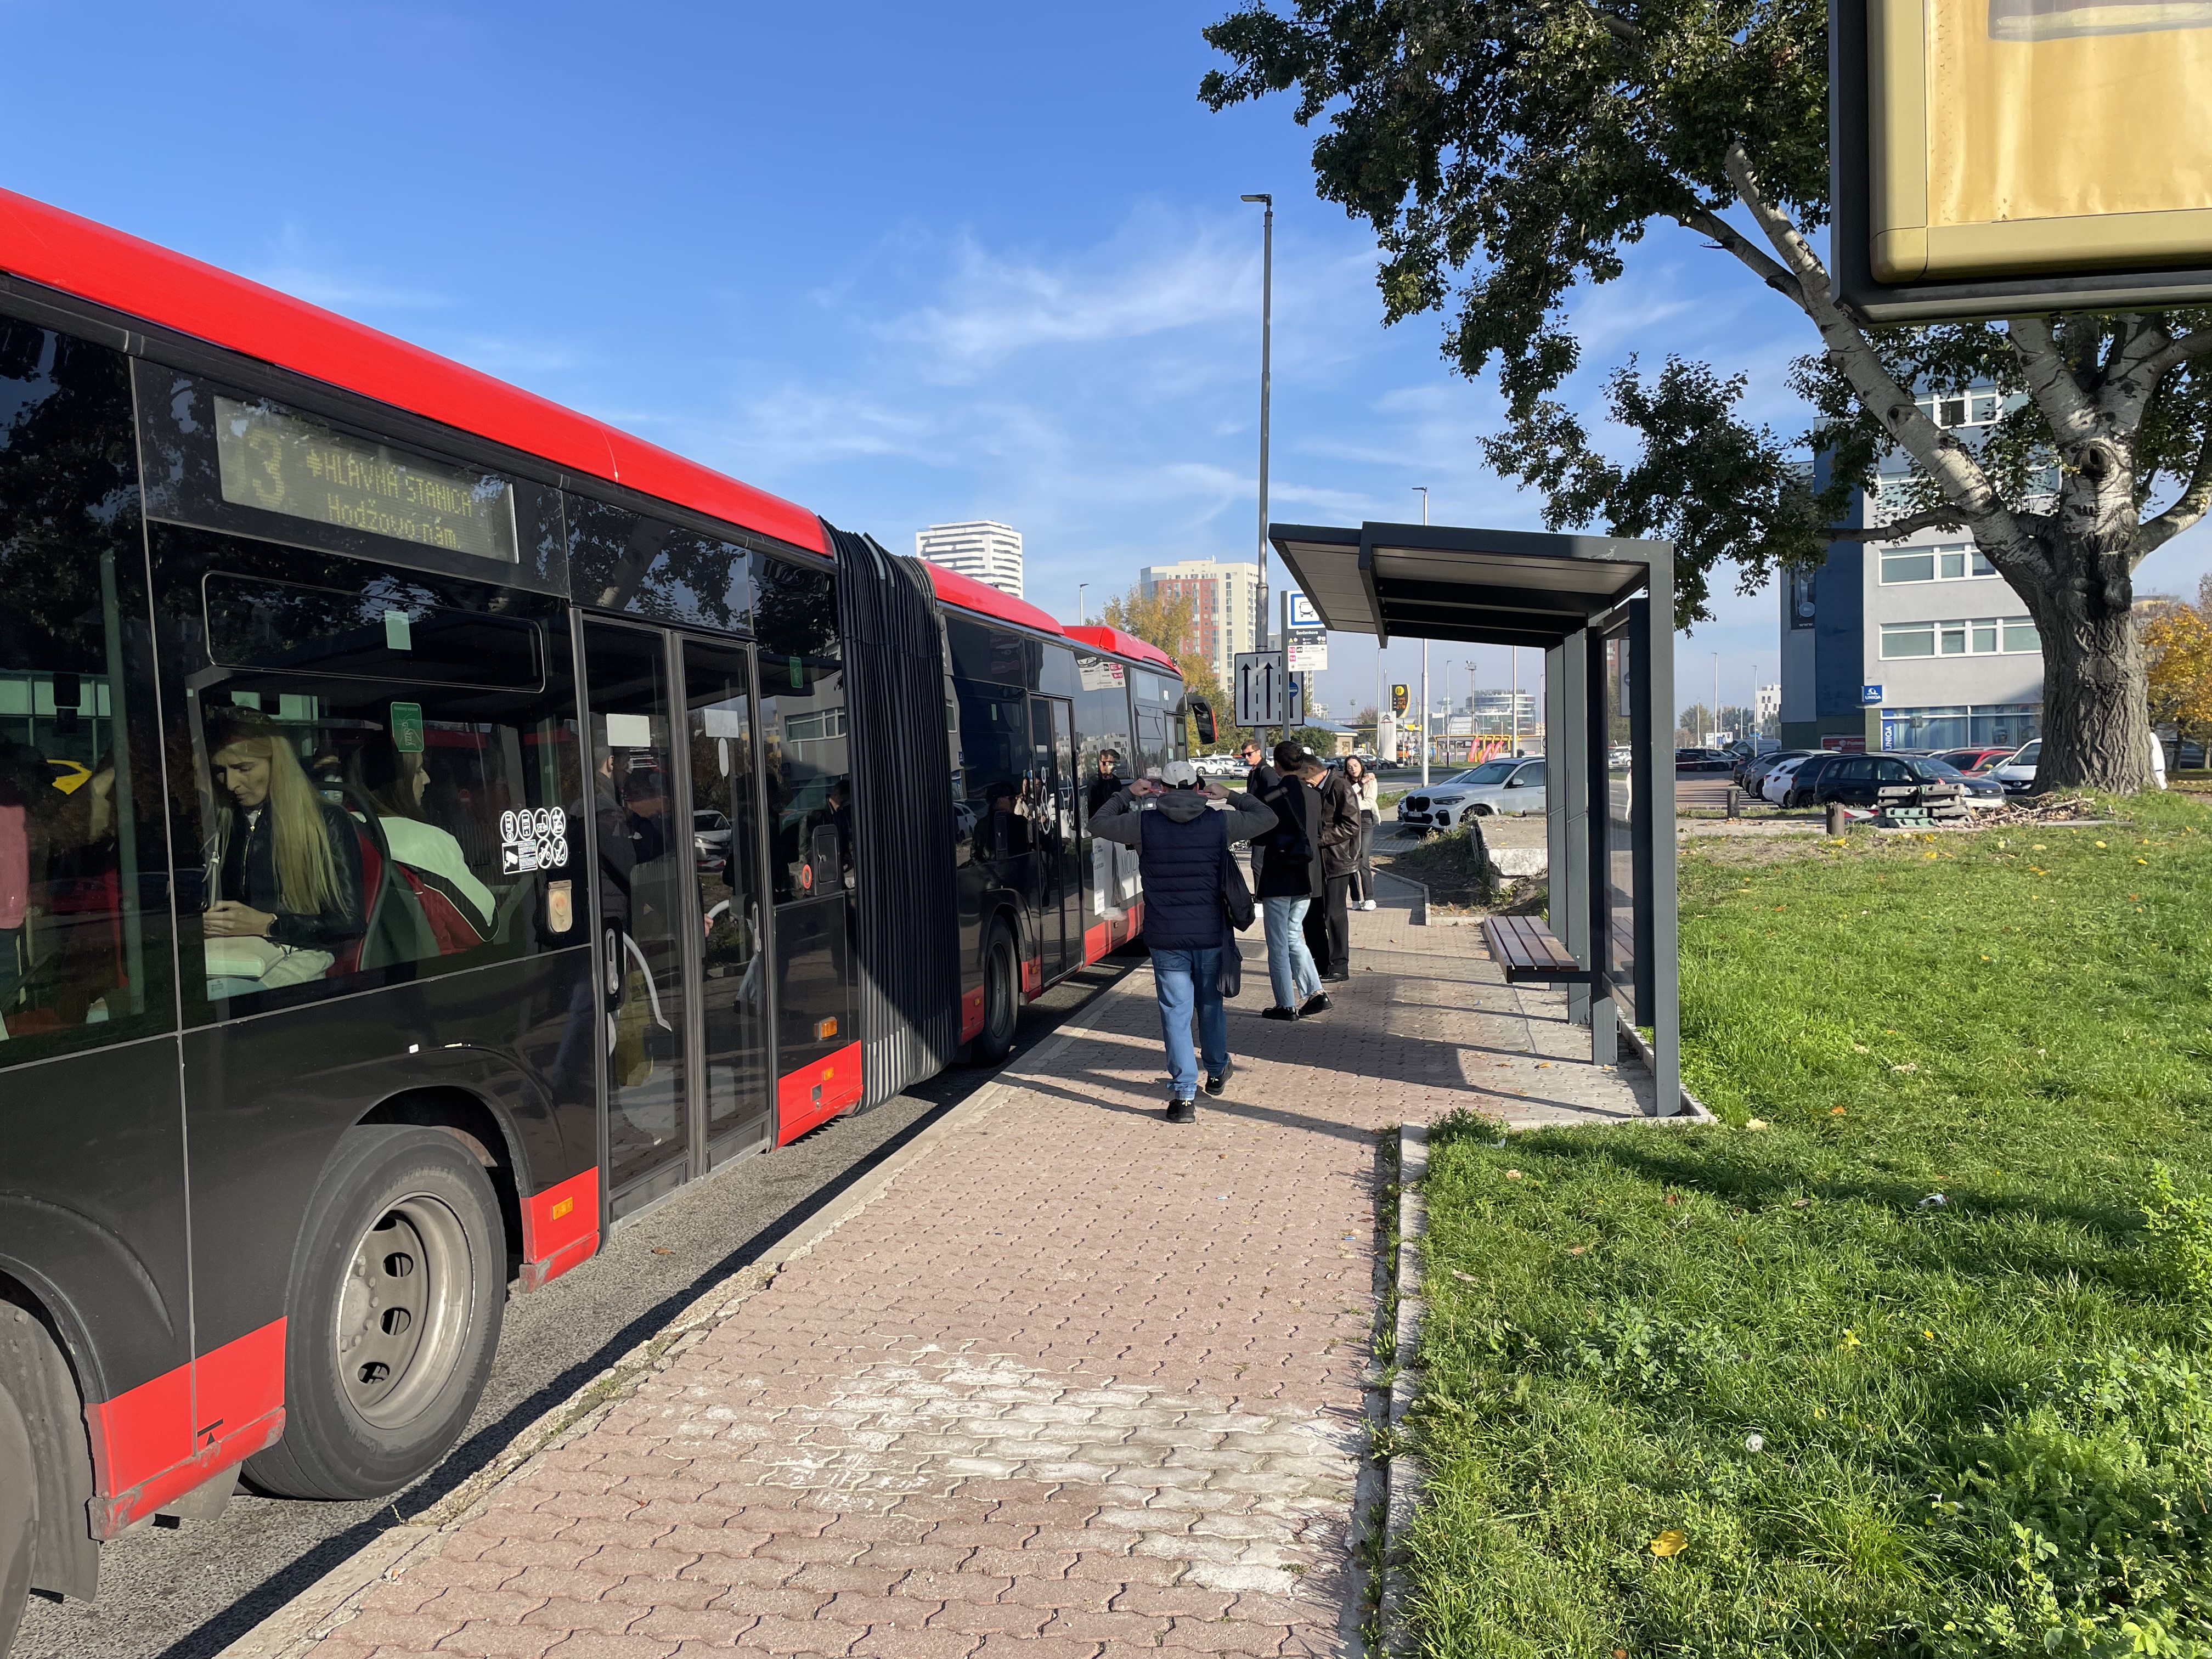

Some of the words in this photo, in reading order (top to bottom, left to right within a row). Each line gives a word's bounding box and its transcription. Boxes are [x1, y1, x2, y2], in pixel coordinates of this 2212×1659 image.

[328, 493, 415, 539] Hodžovo
[405, 476, 472, 517] STANICA
[1884, 726, 1893, 751] UNIQA
